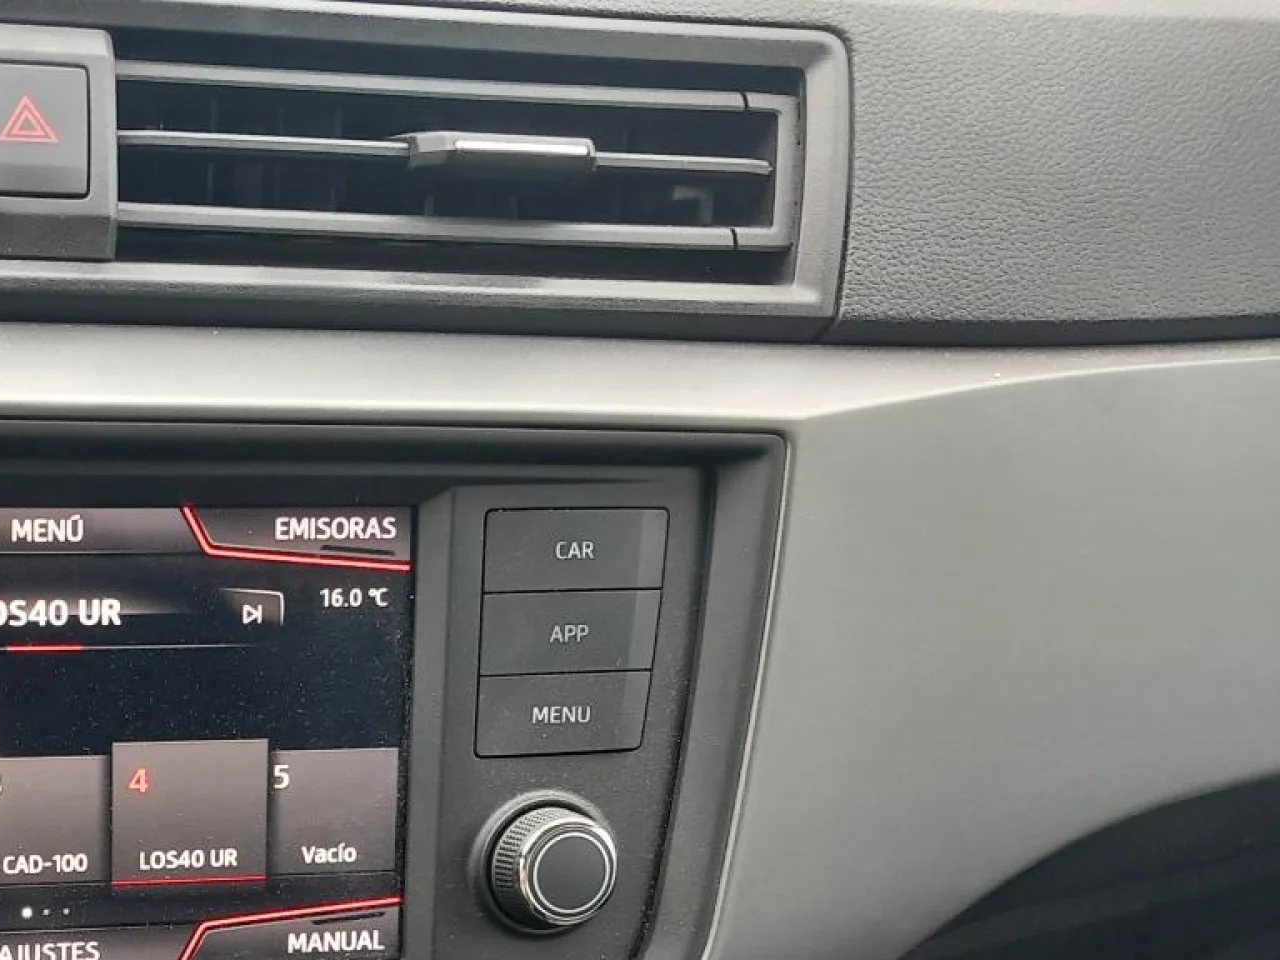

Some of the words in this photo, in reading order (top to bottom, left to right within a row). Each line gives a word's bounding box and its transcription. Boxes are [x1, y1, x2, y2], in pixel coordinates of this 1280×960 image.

[11, 514, 84, 543] MENÚ
[274, 516, 397, 541] EMISORAS
[556, 541, 594, 559] CAR
[319, 587, 363, 608] 16.0
[76, 598, 123, 626] UR
[549, 624, 589, 643] APP
[532, 706, 591, 724] MENU
[129, 768, 148, 793] 4
[274, 764, 291, 789] 5
[2, 852, 88, 875] CAD-100
[139, 849, 204, 871] LOS40
[209, 847, 238, 868] UR
[301, 842, 358, 864] Vacío
[287, 929, 384, 954] MANUAL
